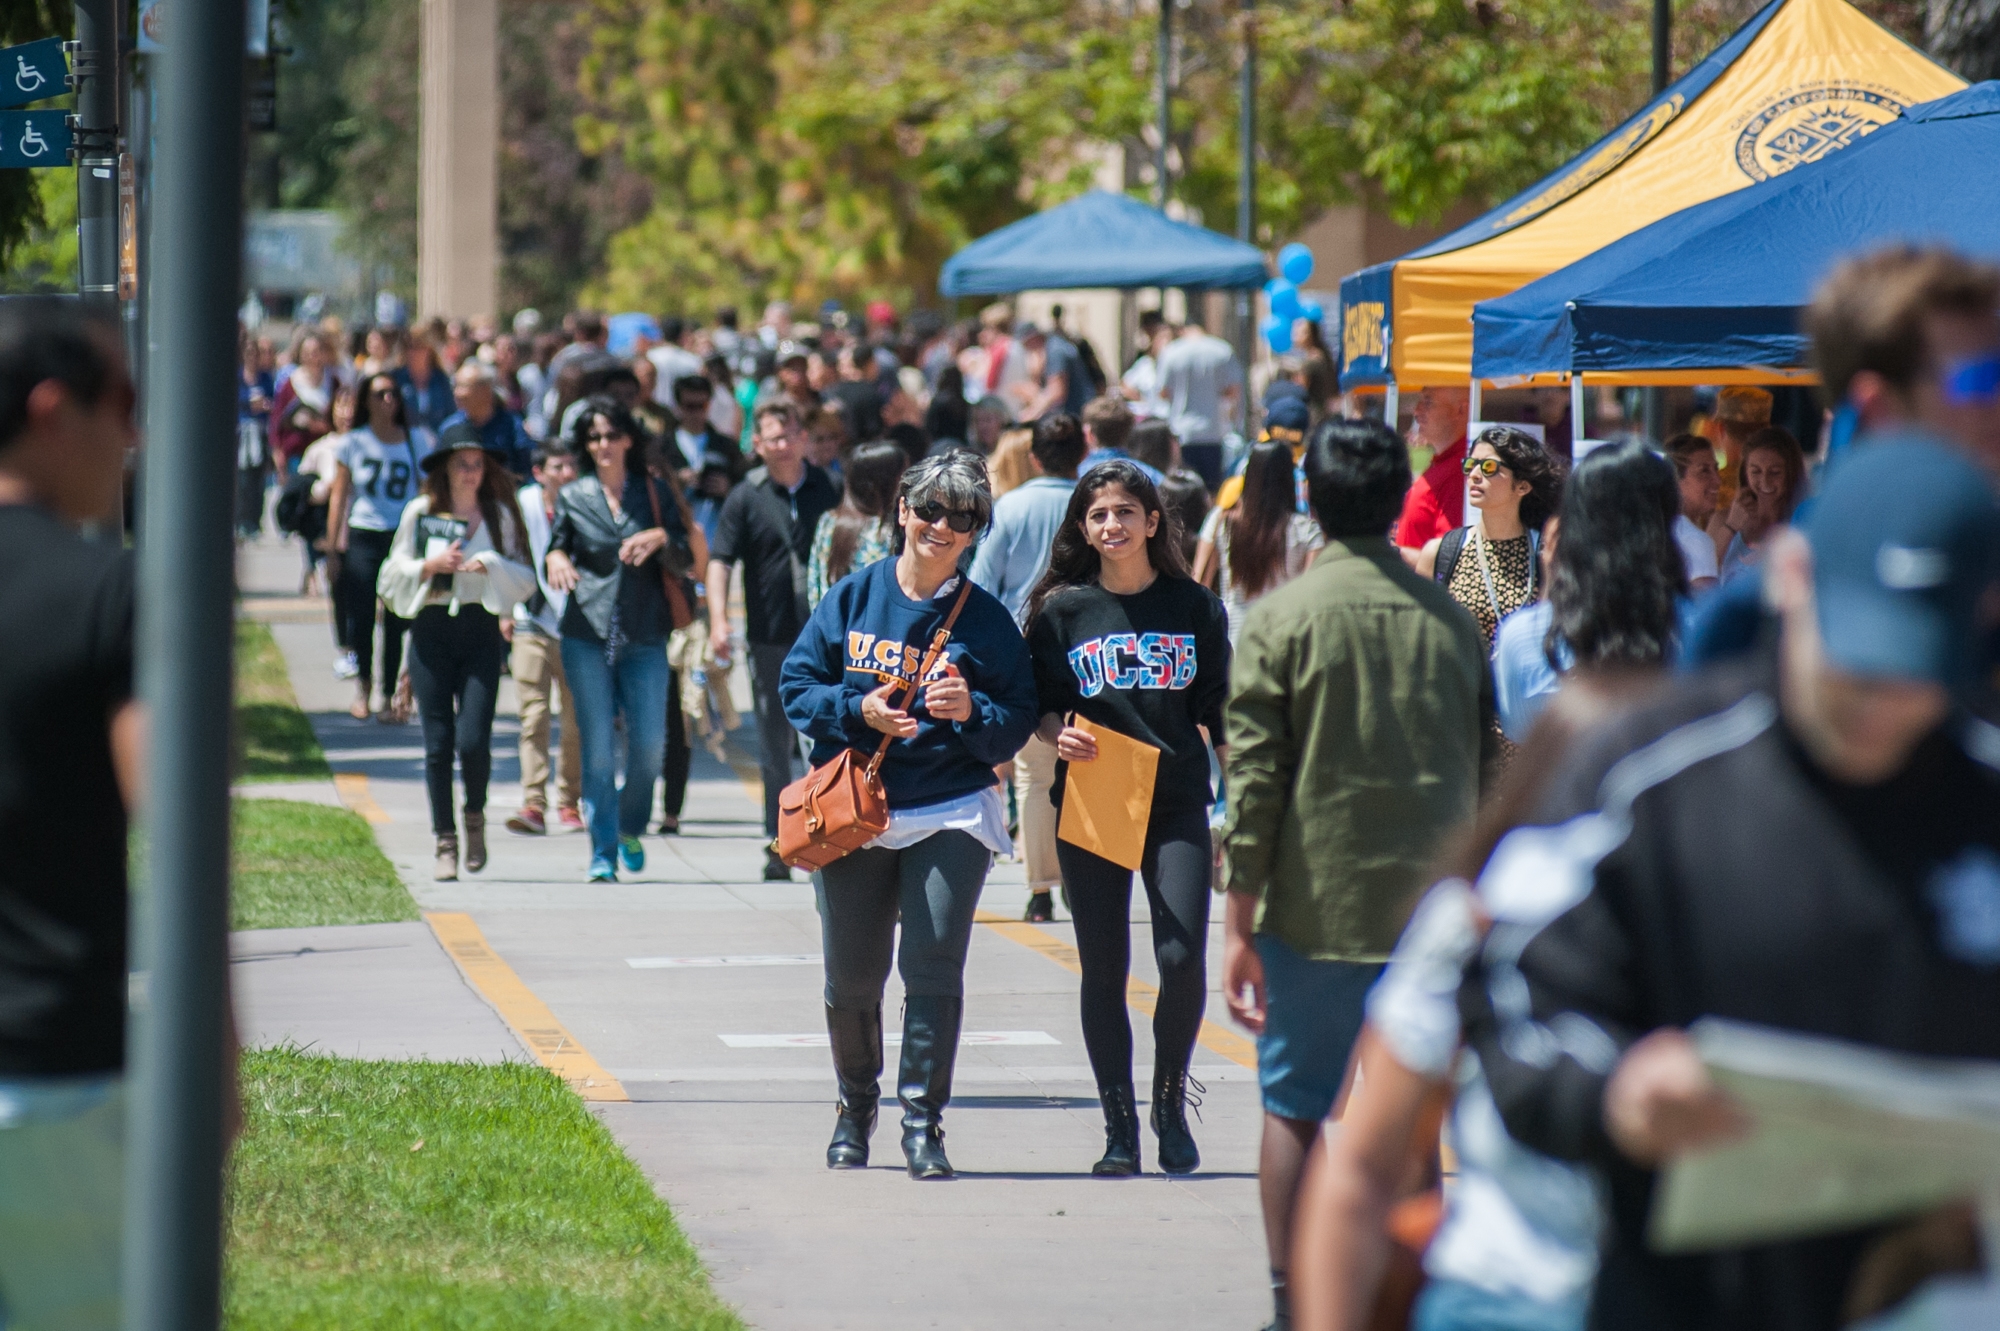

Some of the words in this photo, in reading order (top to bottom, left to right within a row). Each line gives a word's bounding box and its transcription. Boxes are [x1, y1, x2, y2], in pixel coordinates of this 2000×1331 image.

[1763, 88, 1867, 120] CALIFORNIA
[362, 457, 410, 500] 78
[1067, 632, 1198, 698] UCSB
